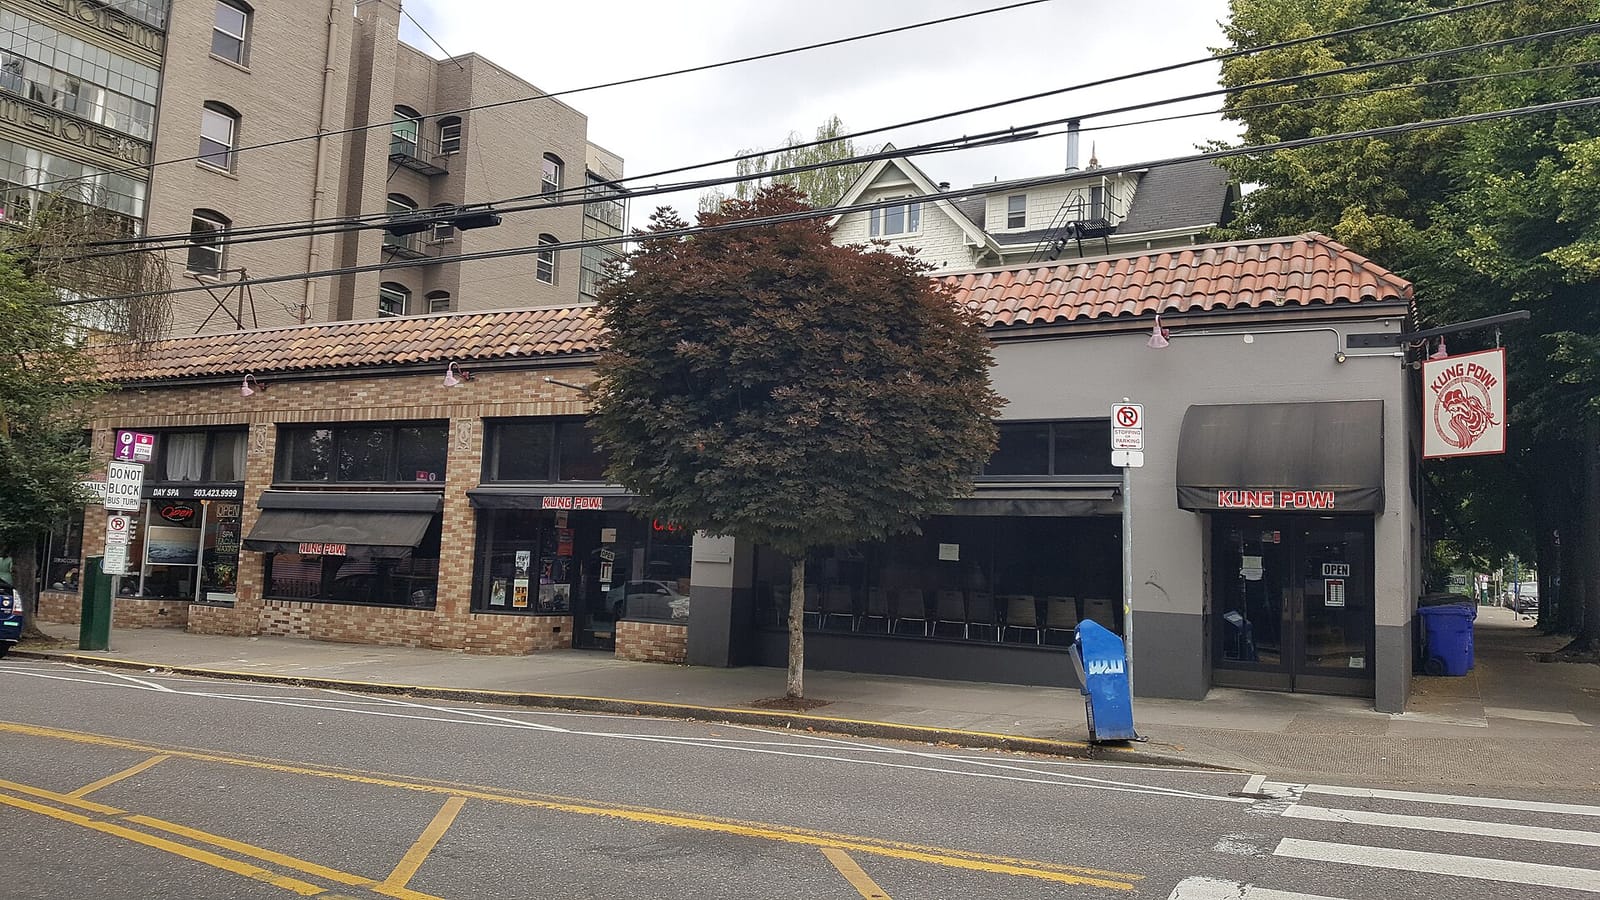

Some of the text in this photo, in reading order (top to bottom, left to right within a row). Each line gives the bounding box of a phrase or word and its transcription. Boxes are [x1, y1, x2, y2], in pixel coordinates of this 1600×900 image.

[1430, 361, 1497, 394] KUNG POW!
[120, 445, 129, 456] 4
[110, 467, 142, 481] DO NOT
[108, 482, 140, 496] BLOCK
[153, 489, 180, 497] DAY SPA
[193, 489, 238, 497] 503.423.9999
[107, 496, 138, 506] BUS TURN
[542, 496, 603, 509] KUNG POW!
[1218, 491, 1335, 509] KUNG POW!
[217, 504, 239, 517] OPEN
[222, 532, 234, 540] SPA
[601, 550, 615, 561] OPEN
[1324, 564, 1348, 576] OPEN
